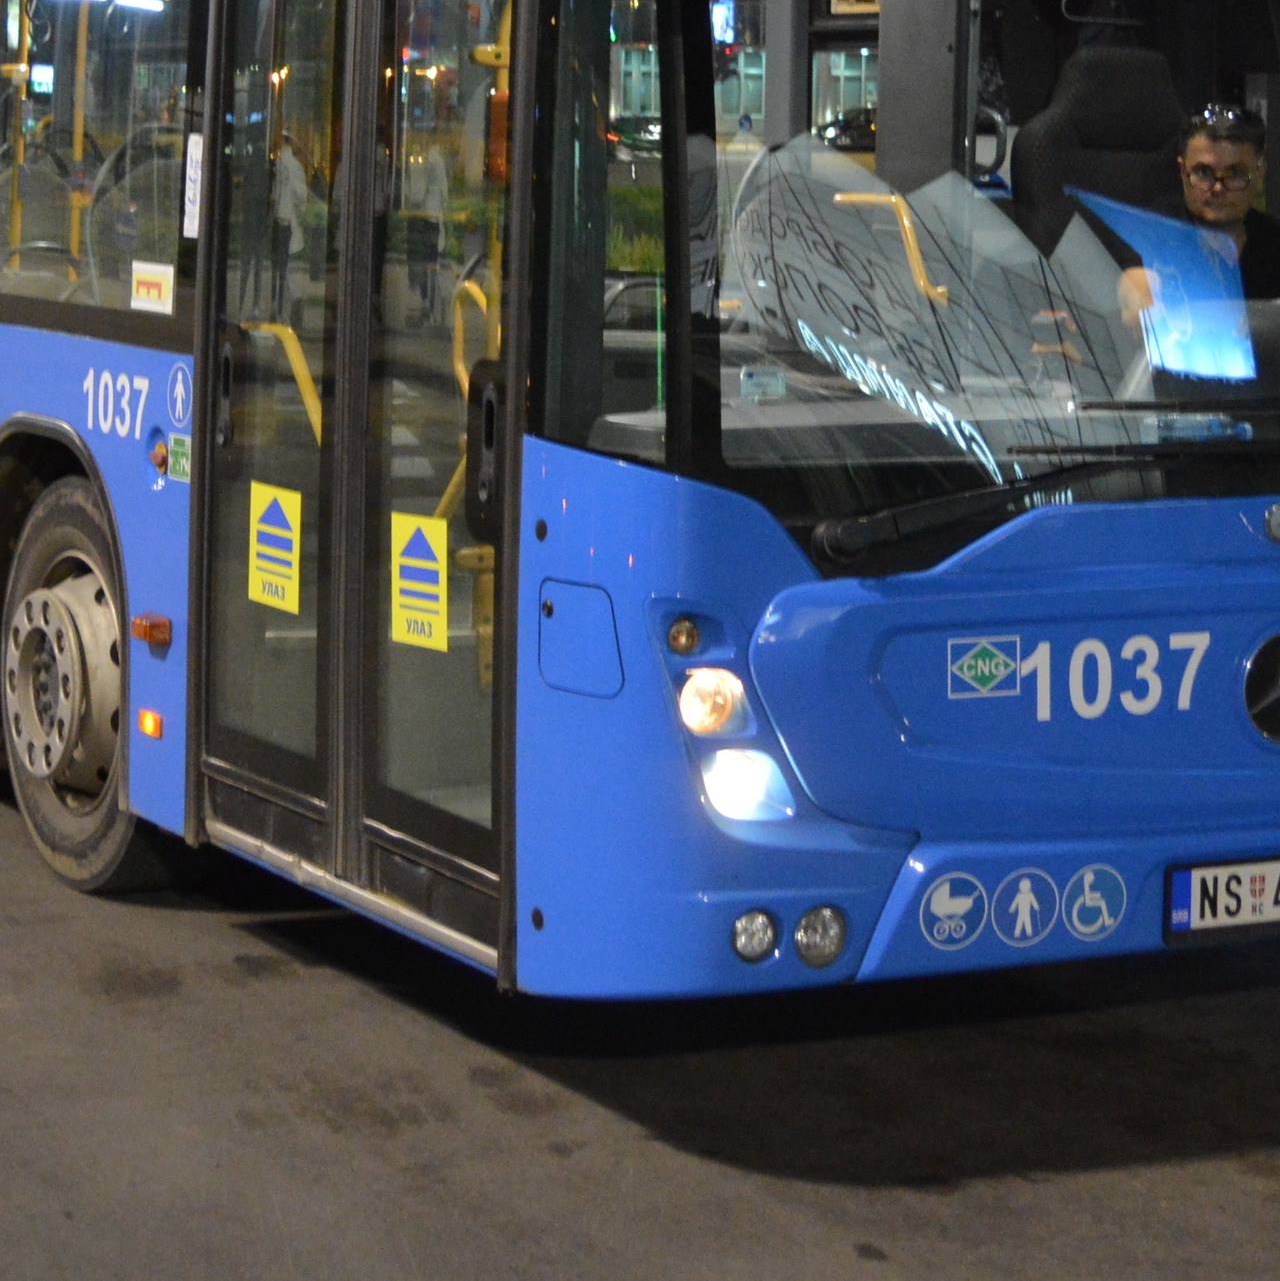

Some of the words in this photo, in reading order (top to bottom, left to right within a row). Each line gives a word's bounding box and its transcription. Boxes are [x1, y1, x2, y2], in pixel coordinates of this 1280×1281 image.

[83, 367, 150, 440] 1037
[260, 579, 286, 601] УЛАЗ
[406, 617, 433, 639] УЛАЗ
[963, 656, 1005, 678] CNG
[1021, 631, 1210, 722] 1037
[1199, 874, 1243, 920] NS
